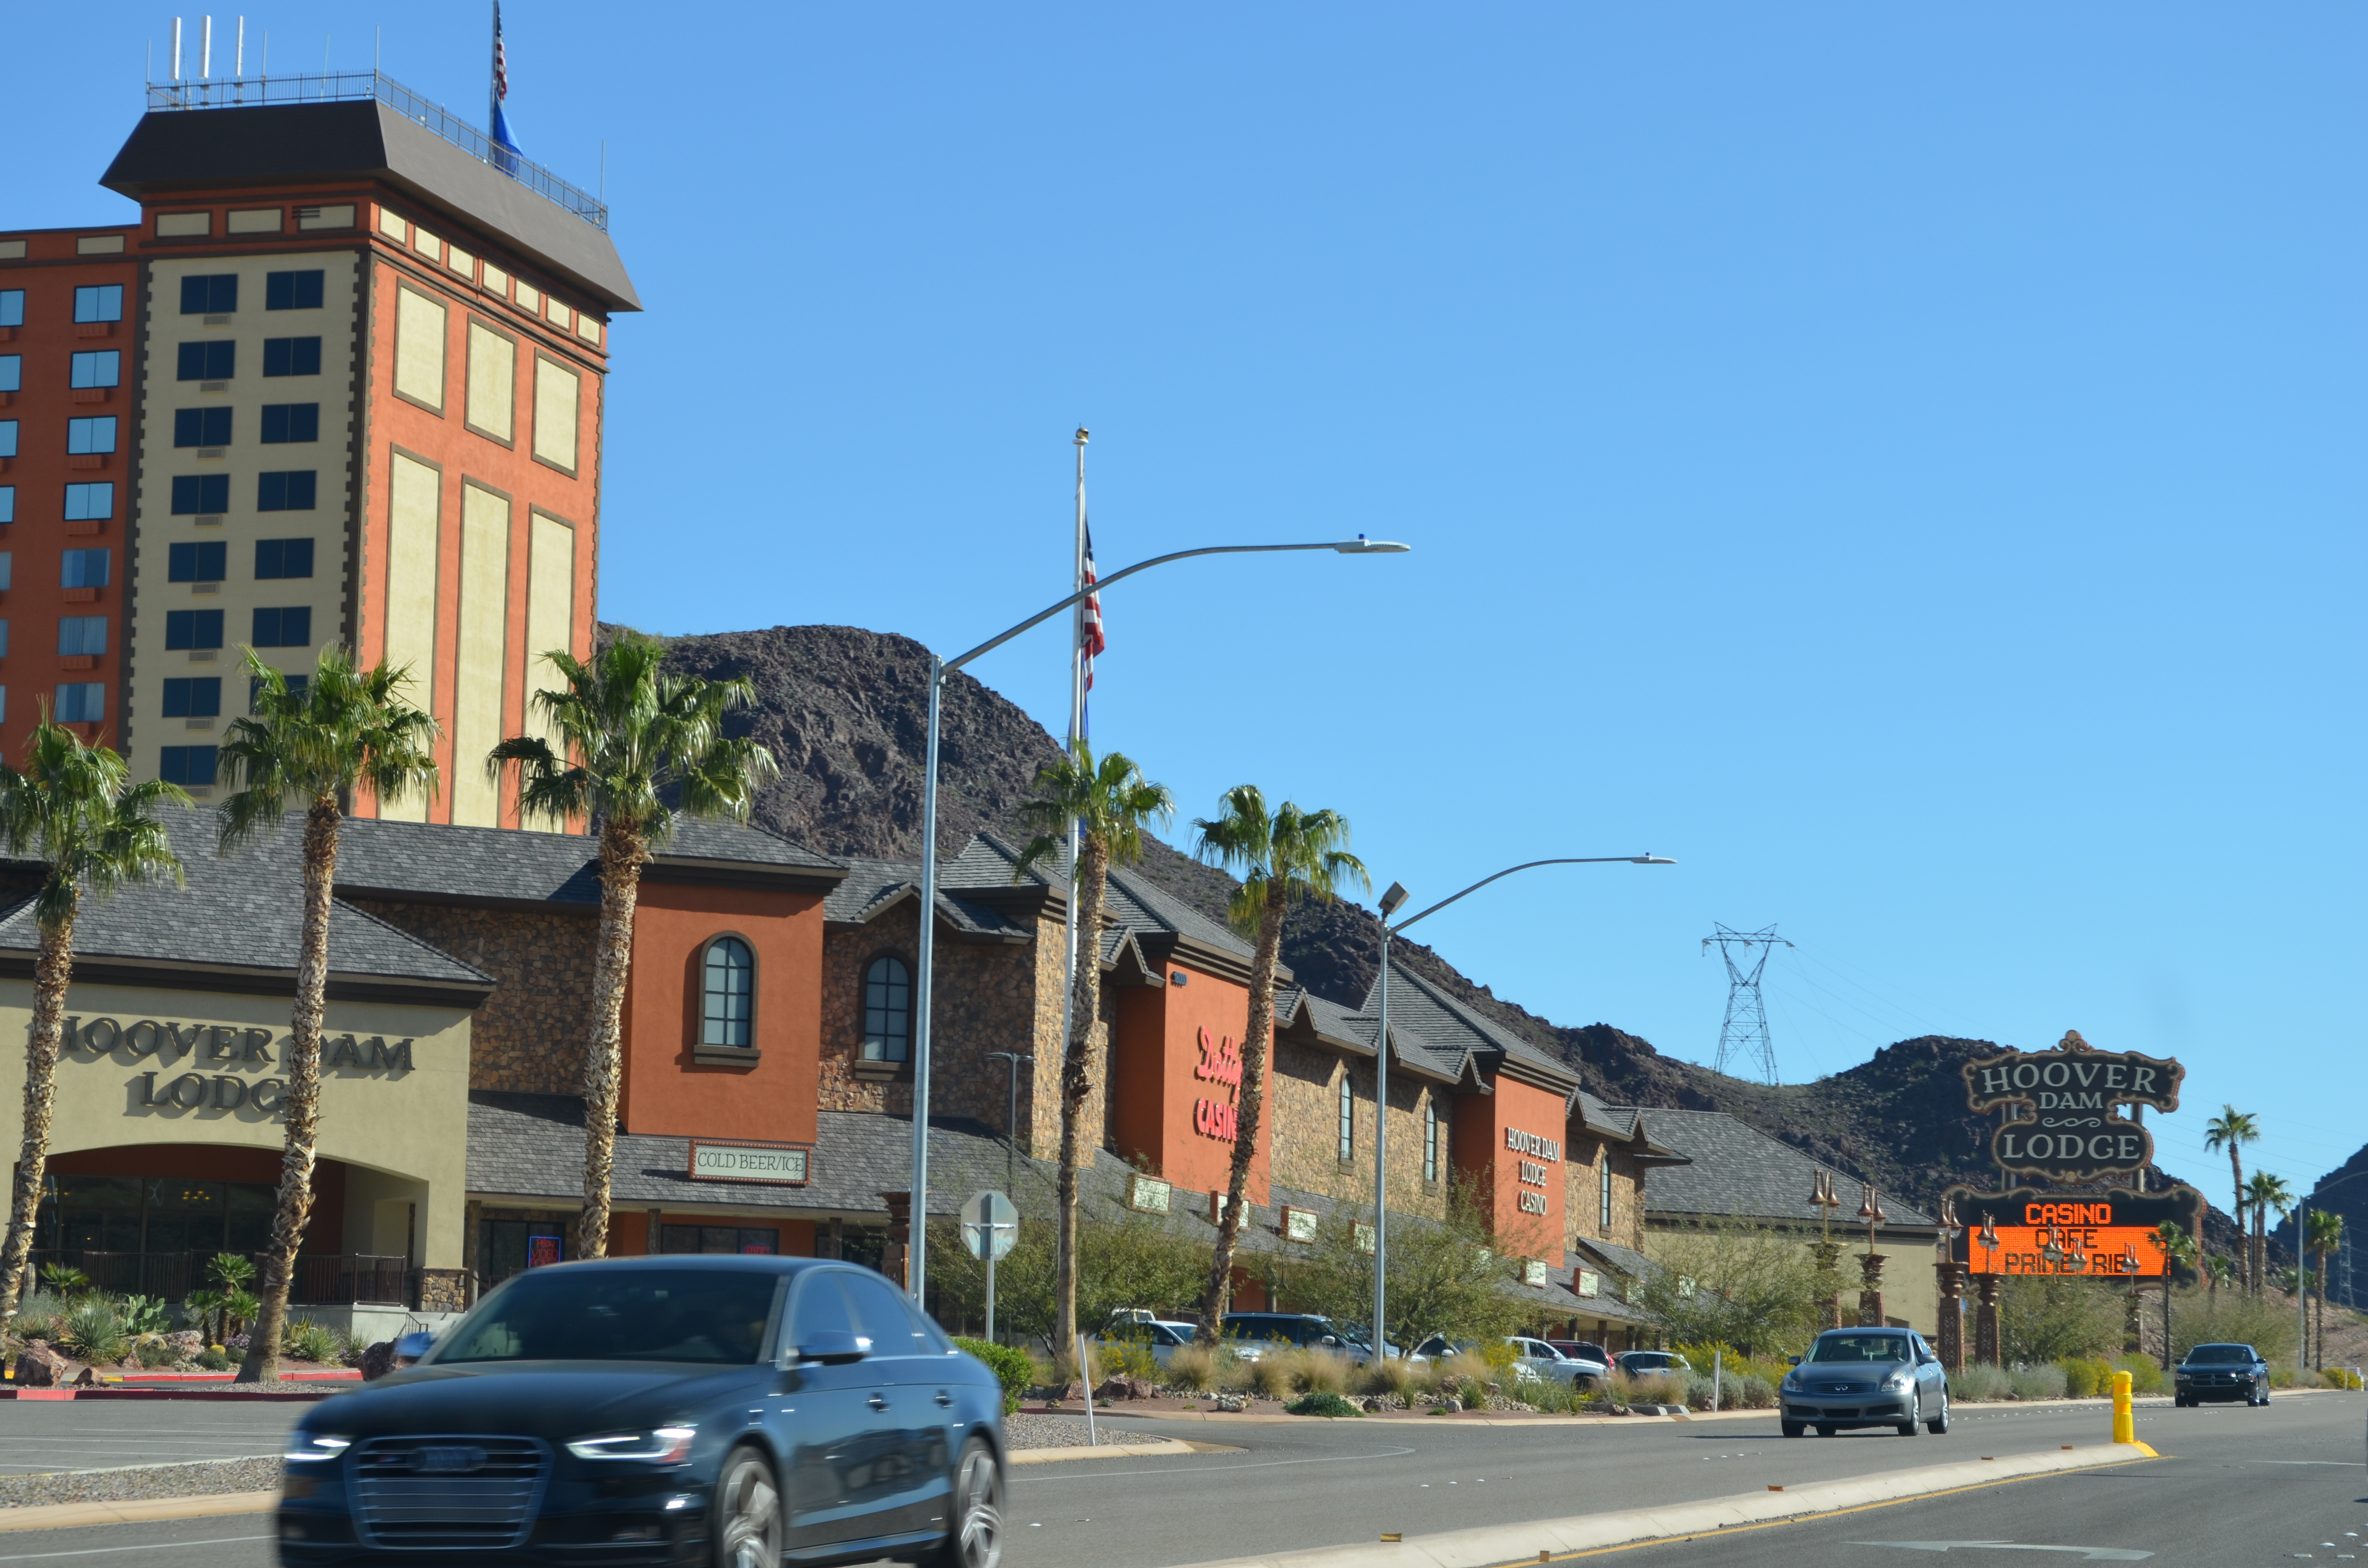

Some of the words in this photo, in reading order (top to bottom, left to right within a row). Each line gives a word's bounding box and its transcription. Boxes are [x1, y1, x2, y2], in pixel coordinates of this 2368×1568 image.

[1174, 971, 1187, 986] 18000
[320, 1033, 416, 1070] AM
[1981, 1062, 2156, 1093] HOOVER
[140, 1071, 288, 1112] LODG
[2039, 1092, 2103, 1109] DAM
[1197, 1097, 1238, 1141] CASIN
[1508, 1127, 1542, 1157] HOOVER
[1542, 1137, 1561, 1162] DAM
[2003, 1134, 2140, 1160] LODGE
[697, 1152, 736, 1168] COLD
[739, 1154, 803, 1171] BEER/ICE
[1521, 1160, 1547, 1186] LODGE
[1521, 1190, 1547, 1215] CASINO
[2025, 1203, 2112, 1225] CASINO
[2035, 1228, 2098, 1249] CAFE
[531, 1249, 558, 1258] VIDEO
